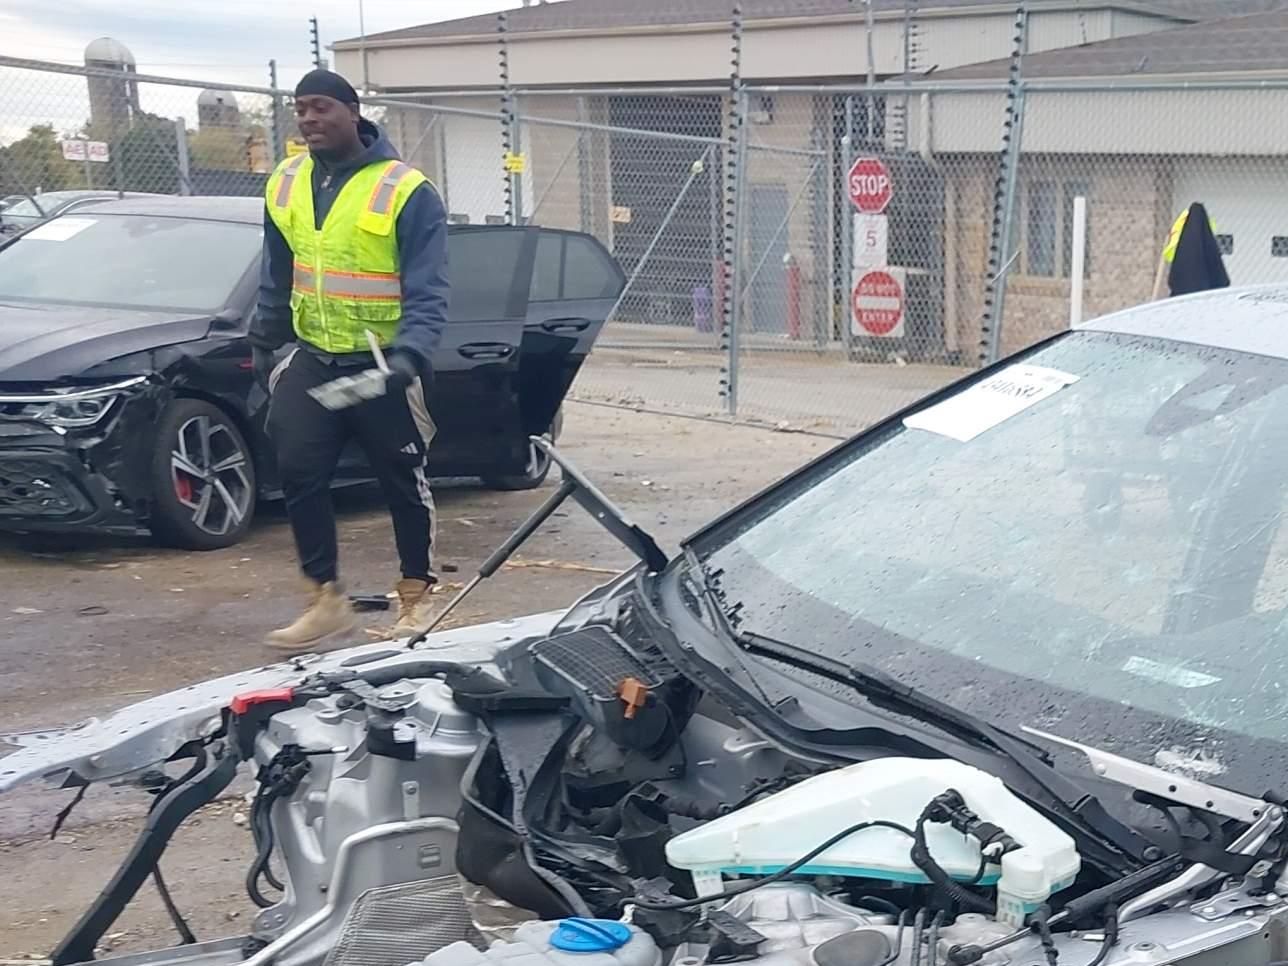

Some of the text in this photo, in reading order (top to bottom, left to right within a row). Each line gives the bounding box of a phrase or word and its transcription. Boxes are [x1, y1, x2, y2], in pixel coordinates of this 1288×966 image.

[851, 175, 887, 196] STOP
[866, 231, 877, 247] 5
[861, 283, 897, 294] DO NOT
[862, 312, 894, 322] ENTER
